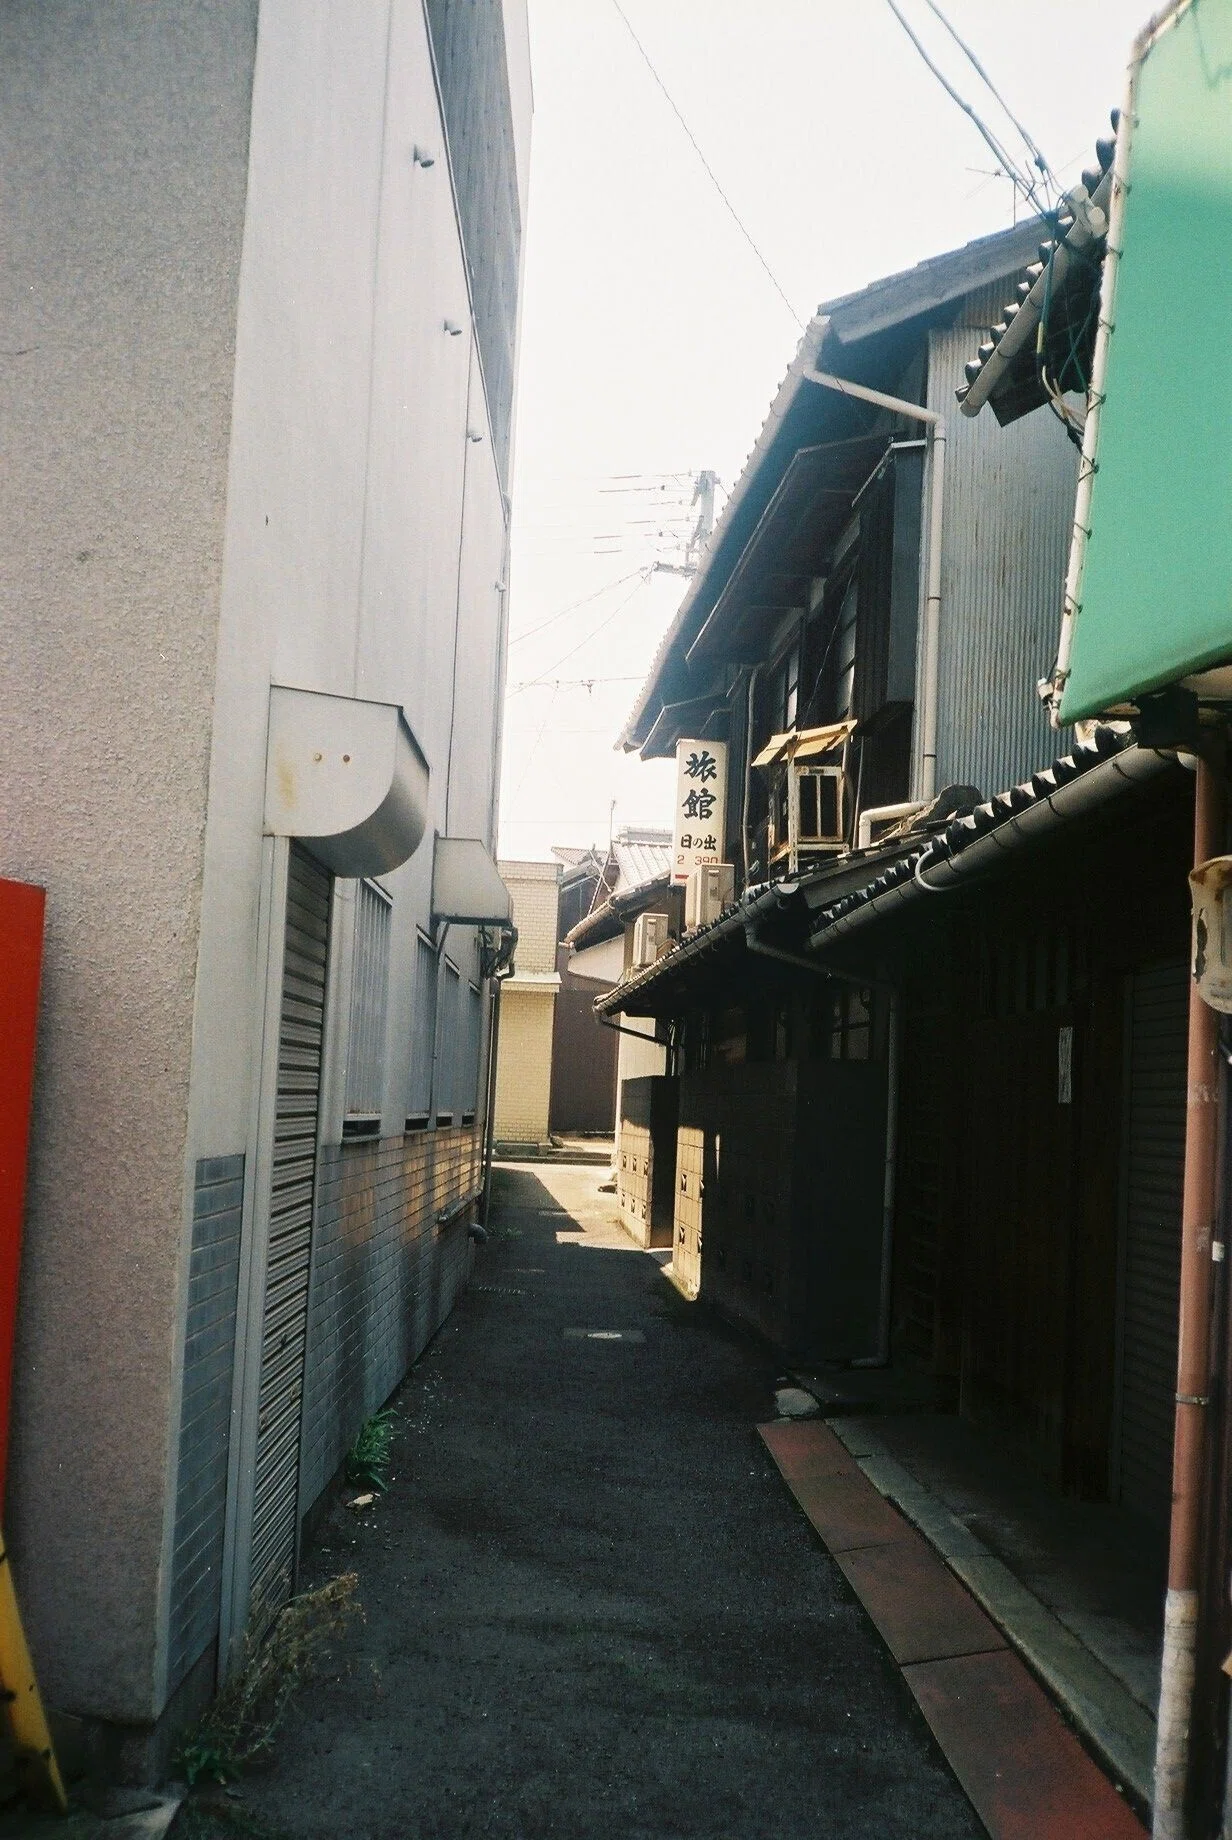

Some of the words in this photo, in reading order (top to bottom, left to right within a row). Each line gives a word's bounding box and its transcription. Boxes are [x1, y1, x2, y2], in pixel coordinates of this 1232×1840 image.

[682, 751, 717, 820] 旅館
[680, 834, 717, 851] 日の出
